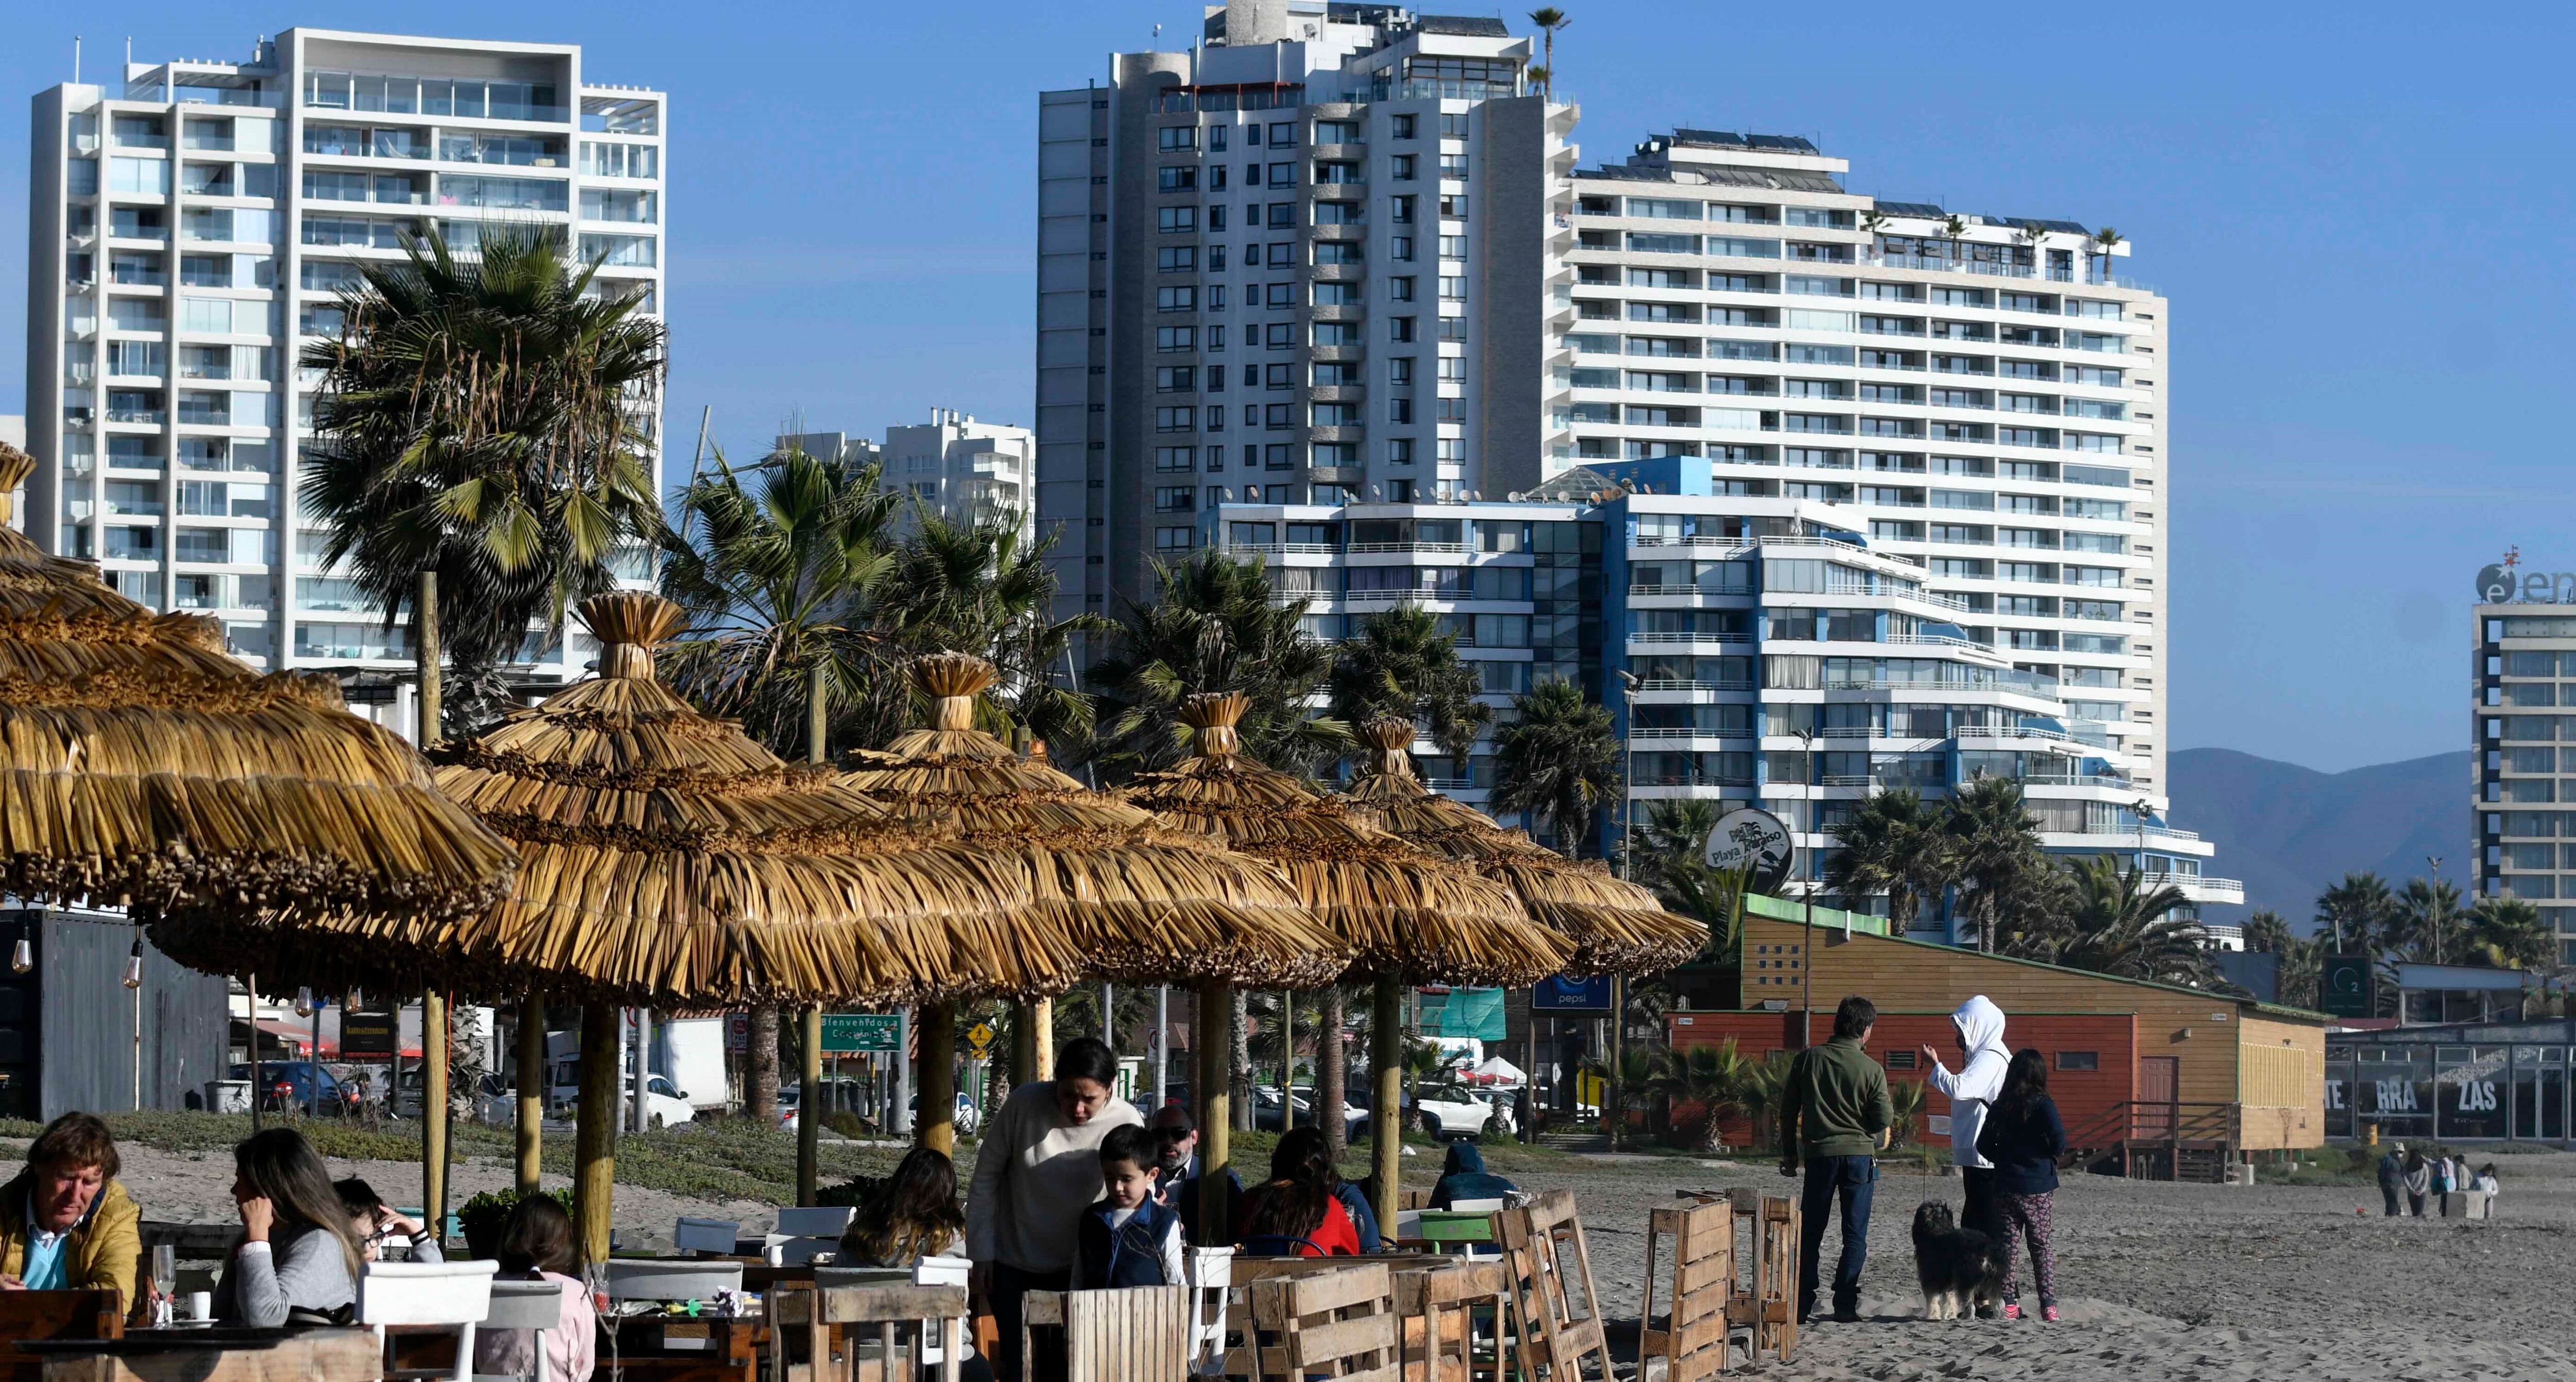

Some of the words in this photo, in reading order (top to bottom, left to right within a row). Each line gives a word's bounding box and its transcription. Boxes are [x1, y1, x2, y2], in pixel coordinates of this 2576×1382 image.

[1711, 847, 1741, 864] Playa
[1559, 994, 1586, 1004] pepsi
[821, 1017, 888, 1026] Bienvenidos
[2376, 1080, 2418, 1110] RRA
[2458, 1080, 2497, 1111] ZAS
